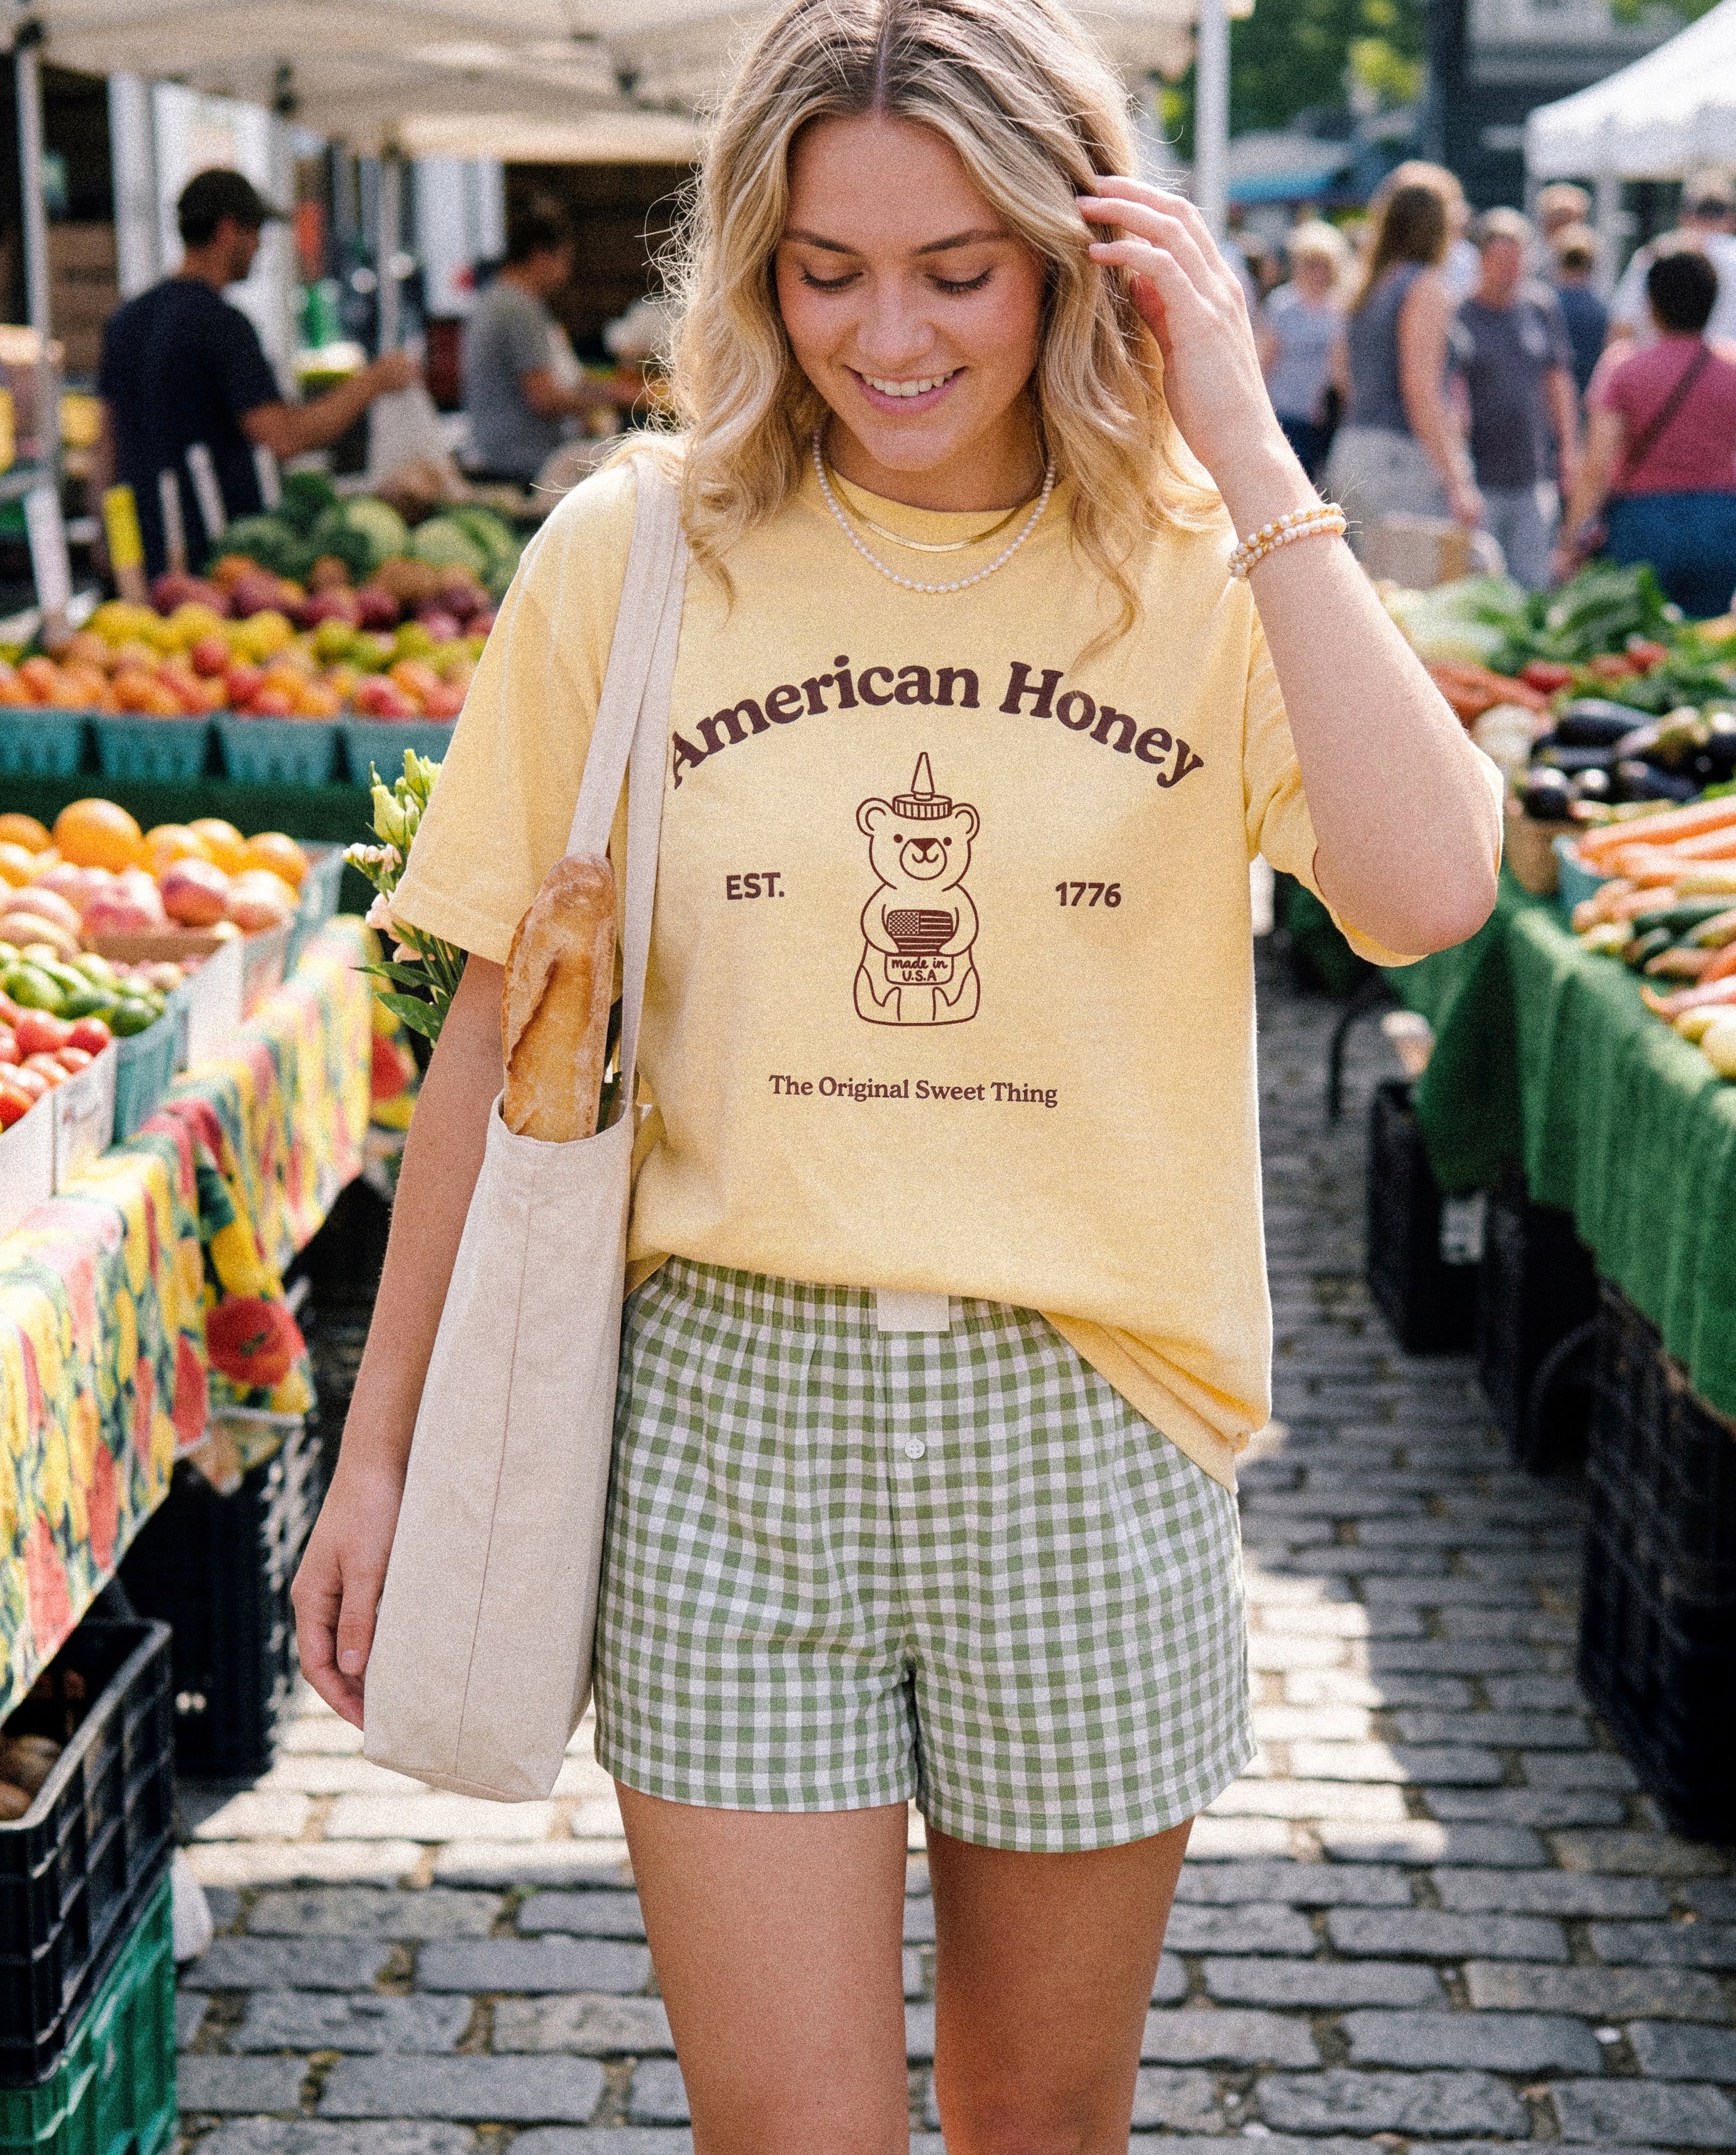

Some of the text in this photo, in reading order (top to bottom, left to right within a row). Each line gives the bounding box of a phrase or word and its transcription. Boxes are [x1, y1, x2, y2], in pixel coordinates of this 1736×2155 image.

[672, 654, 1205, 789] American Honey
[726, 872, 785, 901] EST.
[1055, 881, 1122, 908] 1776
[891, 956, 949, 970] made in
[902, 969, 937, 982] U.S.A
[769, 1074, 1058, 1108] The Original Sweet Thing
